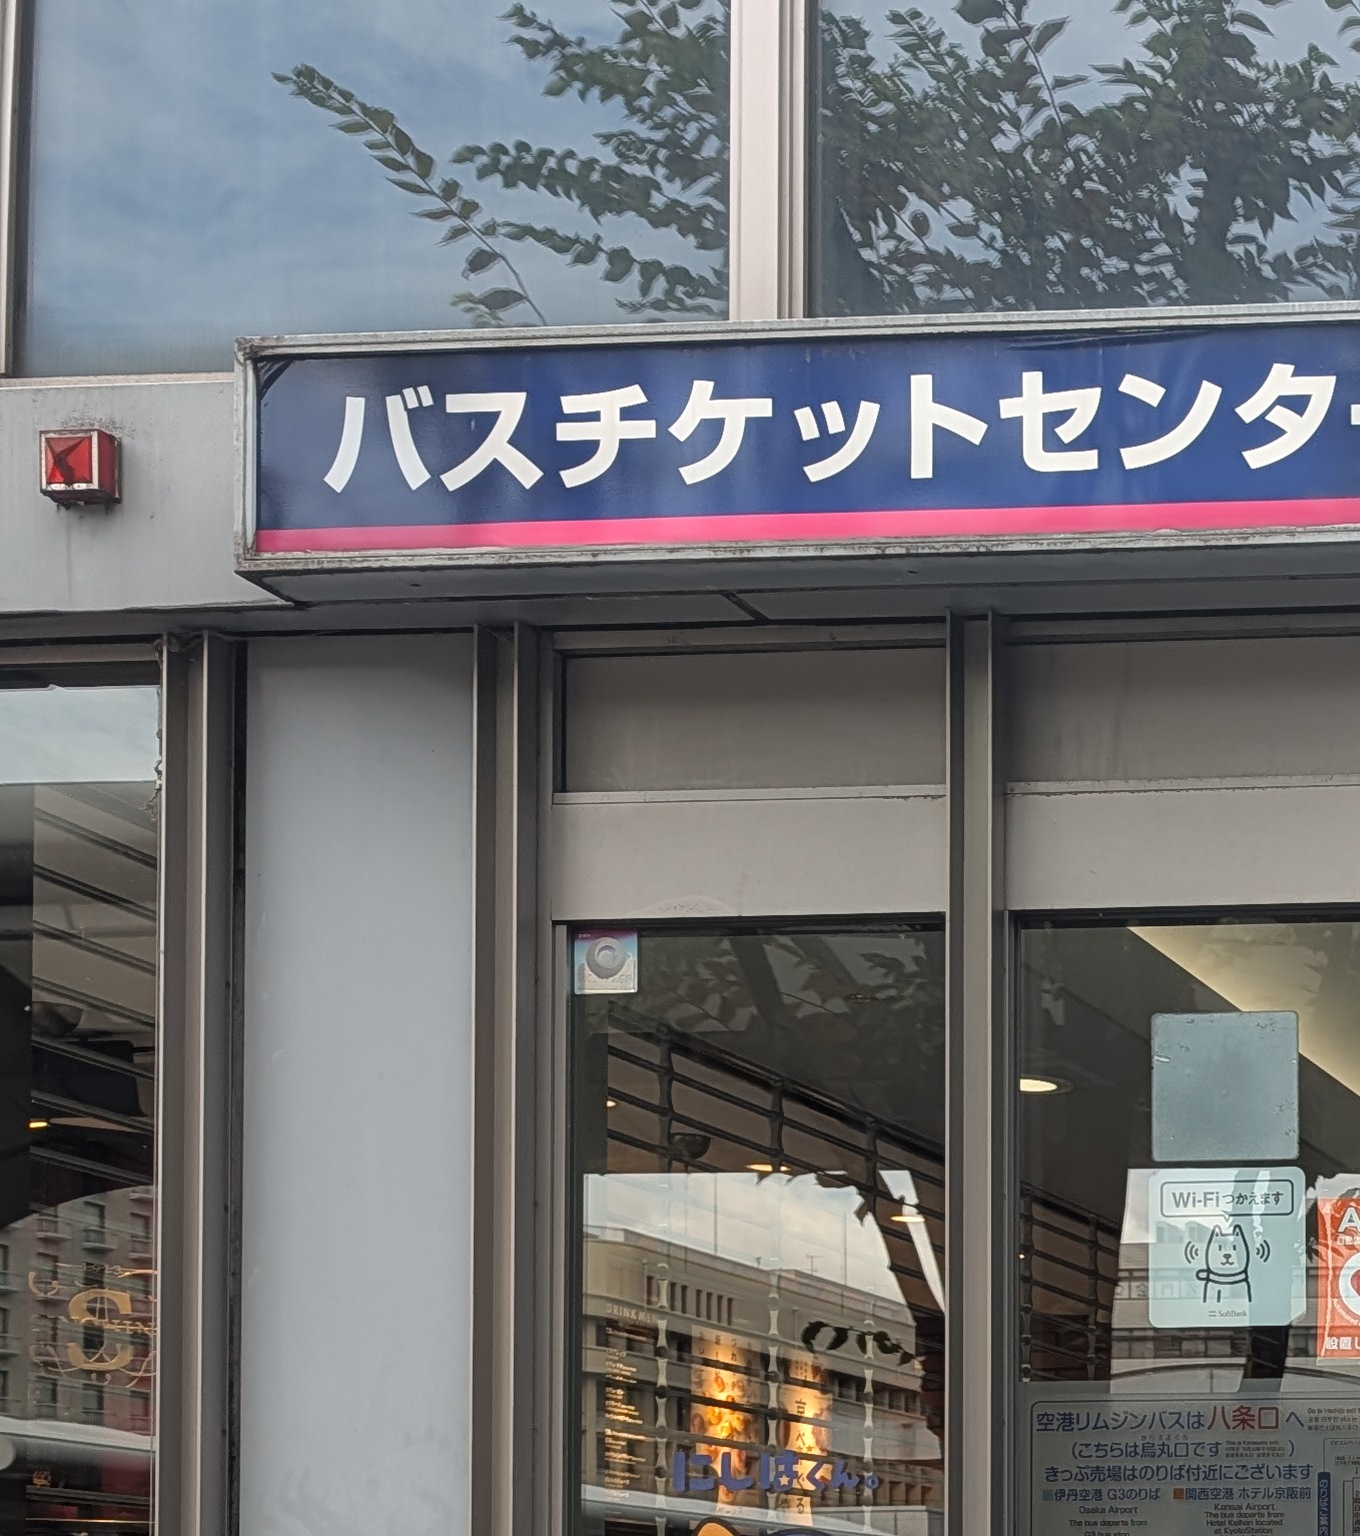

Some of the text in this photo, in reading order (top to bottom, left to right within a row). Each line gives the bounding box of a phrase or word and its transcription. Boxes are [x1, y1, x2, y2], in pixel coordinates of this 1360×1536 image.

[1217, 1309, 1248, 1319] SoftBank
[1044, 1463, 1314, 1483] きっぷ売場はのりば付近にございます
[1054, 1487, 1312, 1501] 伊丹空港 G3のりば 関西空港 ホテル京阪前
[1079, 1505, 1138, 1516] Osaka Airport
[1213, 1502, 1275, 1512] Kansai Airport
[1069, 1519, 1084, 1527] The
[1085, 1519, 1098, 1527] bus
[1130, 1519, 1149, 1527] from
